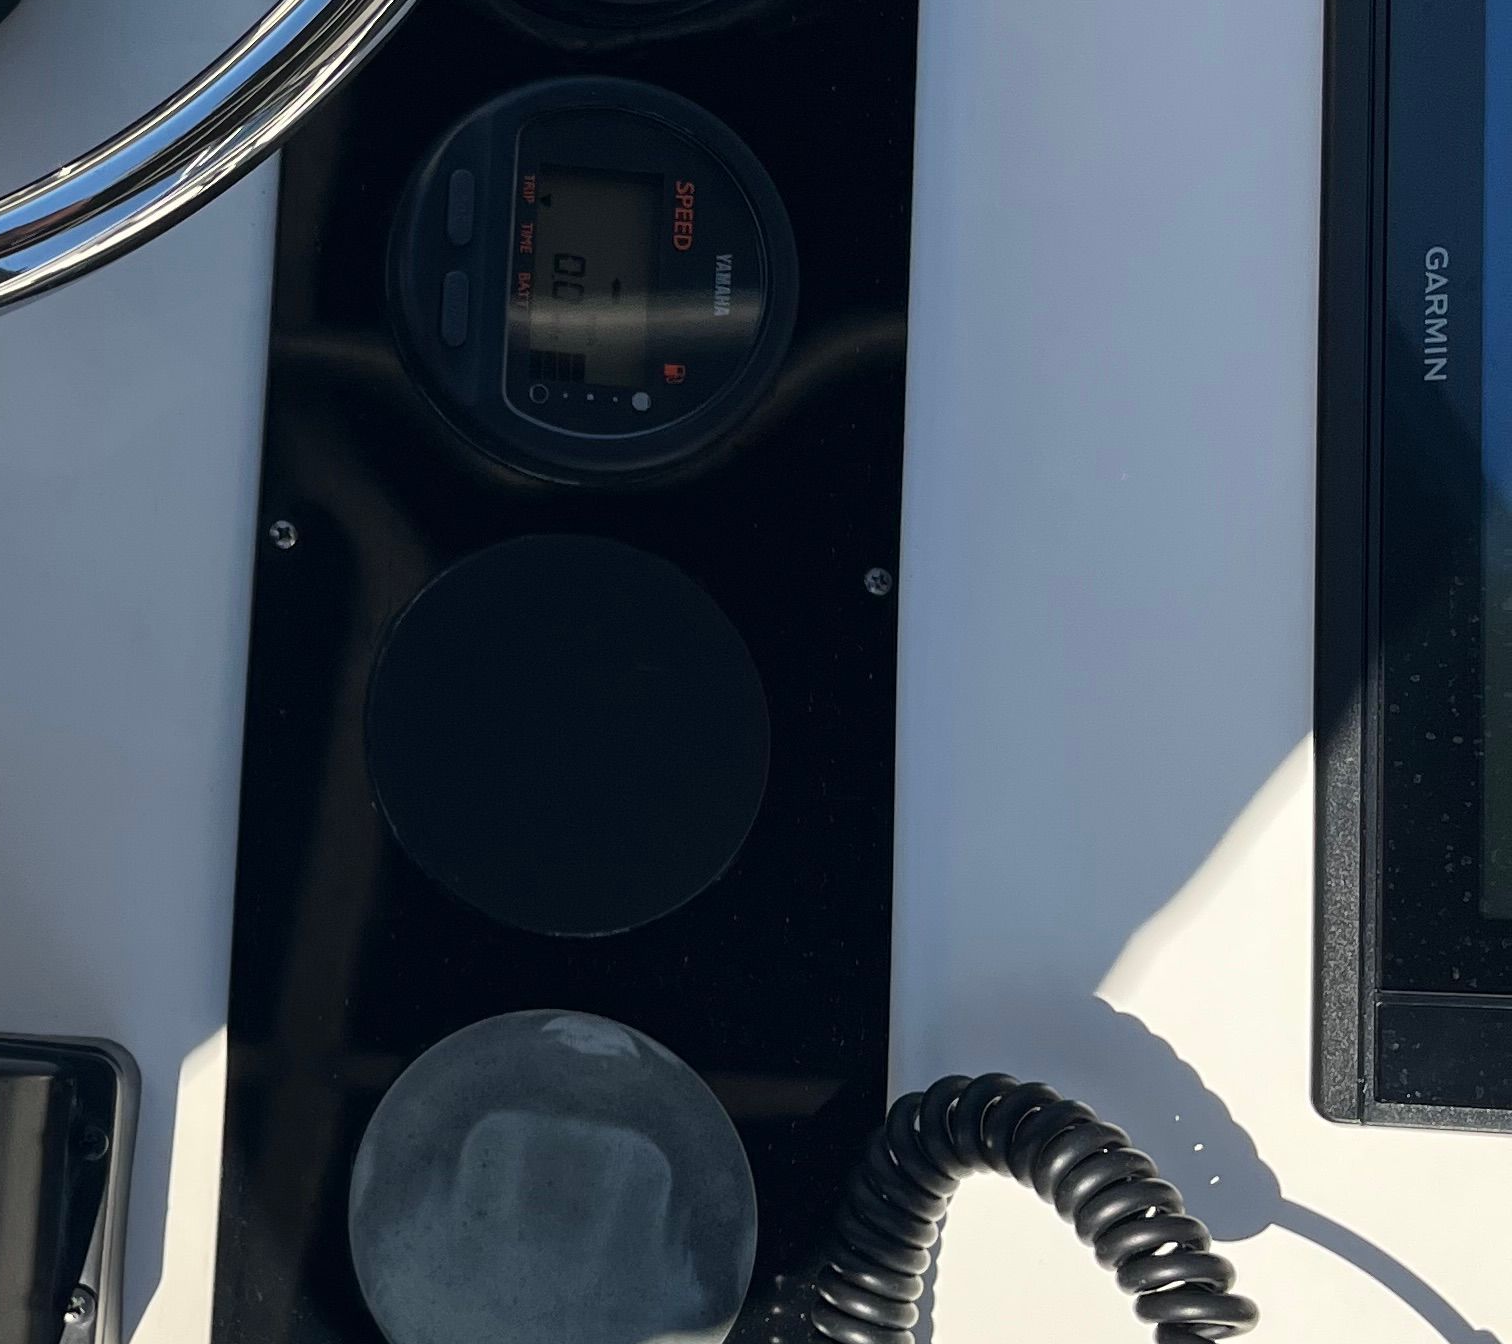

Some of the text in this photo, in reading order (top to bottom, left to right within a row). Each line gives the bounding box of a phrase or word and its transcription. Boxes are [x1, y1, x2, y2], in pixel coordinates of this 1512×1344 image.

[523, 175, 536, 204] TRIP
[672, 180, 696, 252] SPEED
[519, 223, 534, 254] TIME
[714, 254, 733, 316] YAMAHA
[1423, 246, 1450, 382] GARMIN
